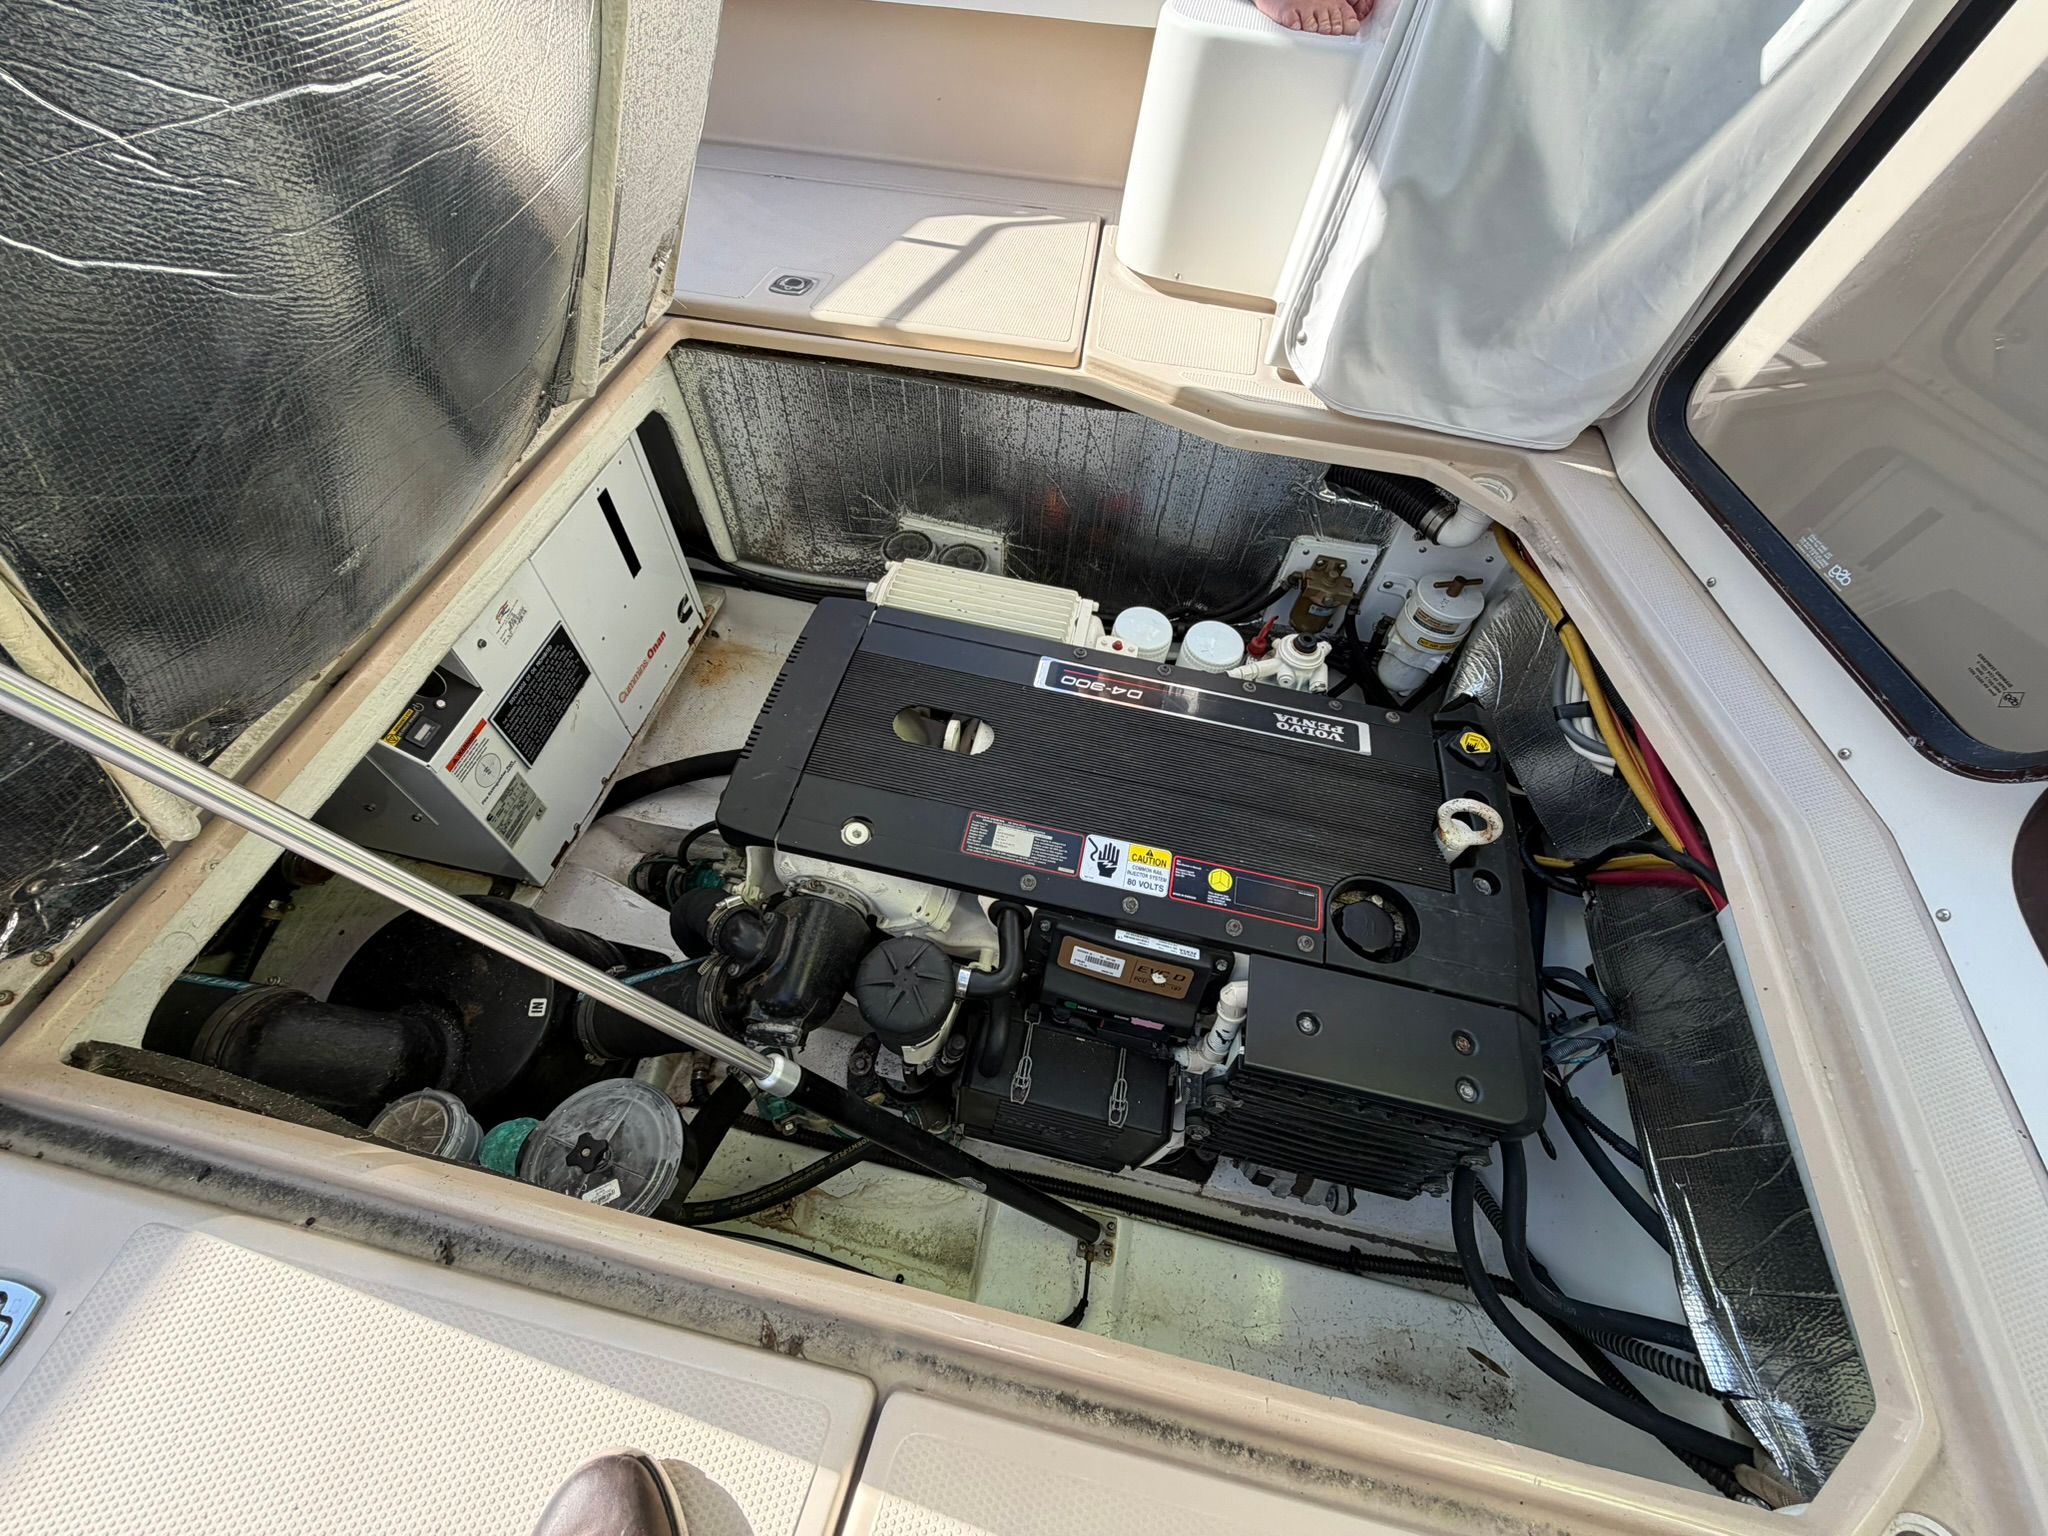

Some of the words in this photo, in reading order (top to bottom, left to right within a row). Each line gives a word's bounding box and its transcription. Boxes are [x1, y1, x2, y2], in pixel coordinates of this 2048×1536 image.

[618, 659, 649, 703] Cummins
[647, 630, 666, 659] Onan
[508, 681, 527, 705] DISCHARGE
[1061, 675, 1143, 700] D4-300
[1272, 712, 1345, 735] PENTA
[1276, 721, 1345, 742] VOLVO
[1131, 853, 1167, 868] CAUTION
[1132, 864, 1152, 873] COMMON
[1127, 869, 1149, 879] INJECTOR
[1150, 875, 1167, 883] SYSTEM
[1127, 878, 1137, 887] 80
[1138, 881, 1164, 893] VOLTS
[531, 1002, 544, 1013] IN
